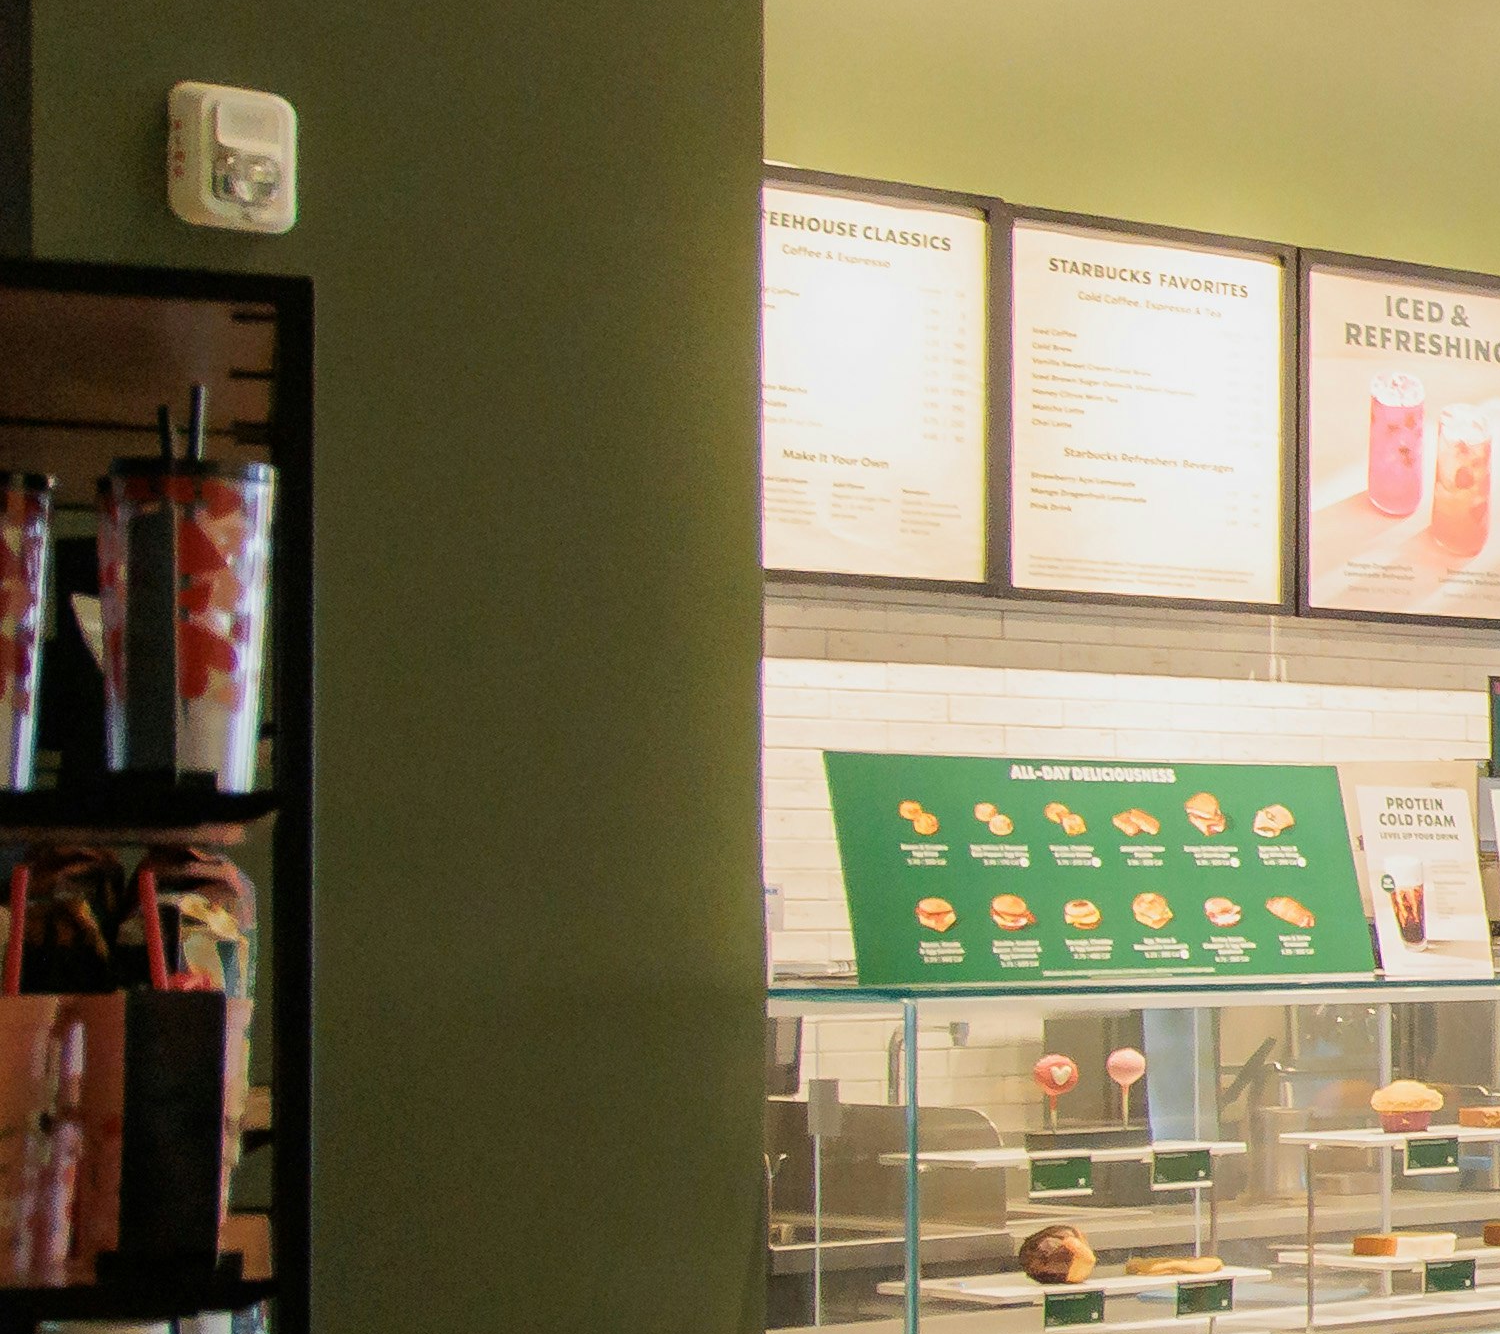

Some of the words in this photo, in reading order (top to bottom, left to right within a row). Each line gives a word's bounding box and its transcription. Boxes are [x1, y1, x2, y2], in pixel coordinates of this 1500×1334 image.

[863, 225, 952, 252] CLASSICS
[781, 243, 822, 260] Coffee
[1048, 256, 1152, 287] STARBUCKS
[1160, 272, 1249, 299] FAVORITES
[1077, 289, 1102, 303] Cold
[1384, 294, 1444, 326] ICED
[1451, 303, 1471, 328] &
[782, 447, 817, 465] Make
[831, 454, 858, 466] Your
[860, 457, 890, 469] Own
[1063, 446, 1117, 462] Starbucks
[1182, 458, 1235, 474] Beverages
[1009, 763, 1073, 784] ALL-DAY
[1071, 765, 1177, 784] DELICIOUSNESS
[1385, 795, 1445, 813] PROTEIN
[1378, 811, 1414, 828] COLD
[1416, 813, 1457, 829] FOAM
[1379, 831, 1400, 841] LEVEL
[1401, 832, 1413, 841] UP
[1413, 832, 1435, 842] YOUR
[1435, 833, 1460, 842] DRINK
